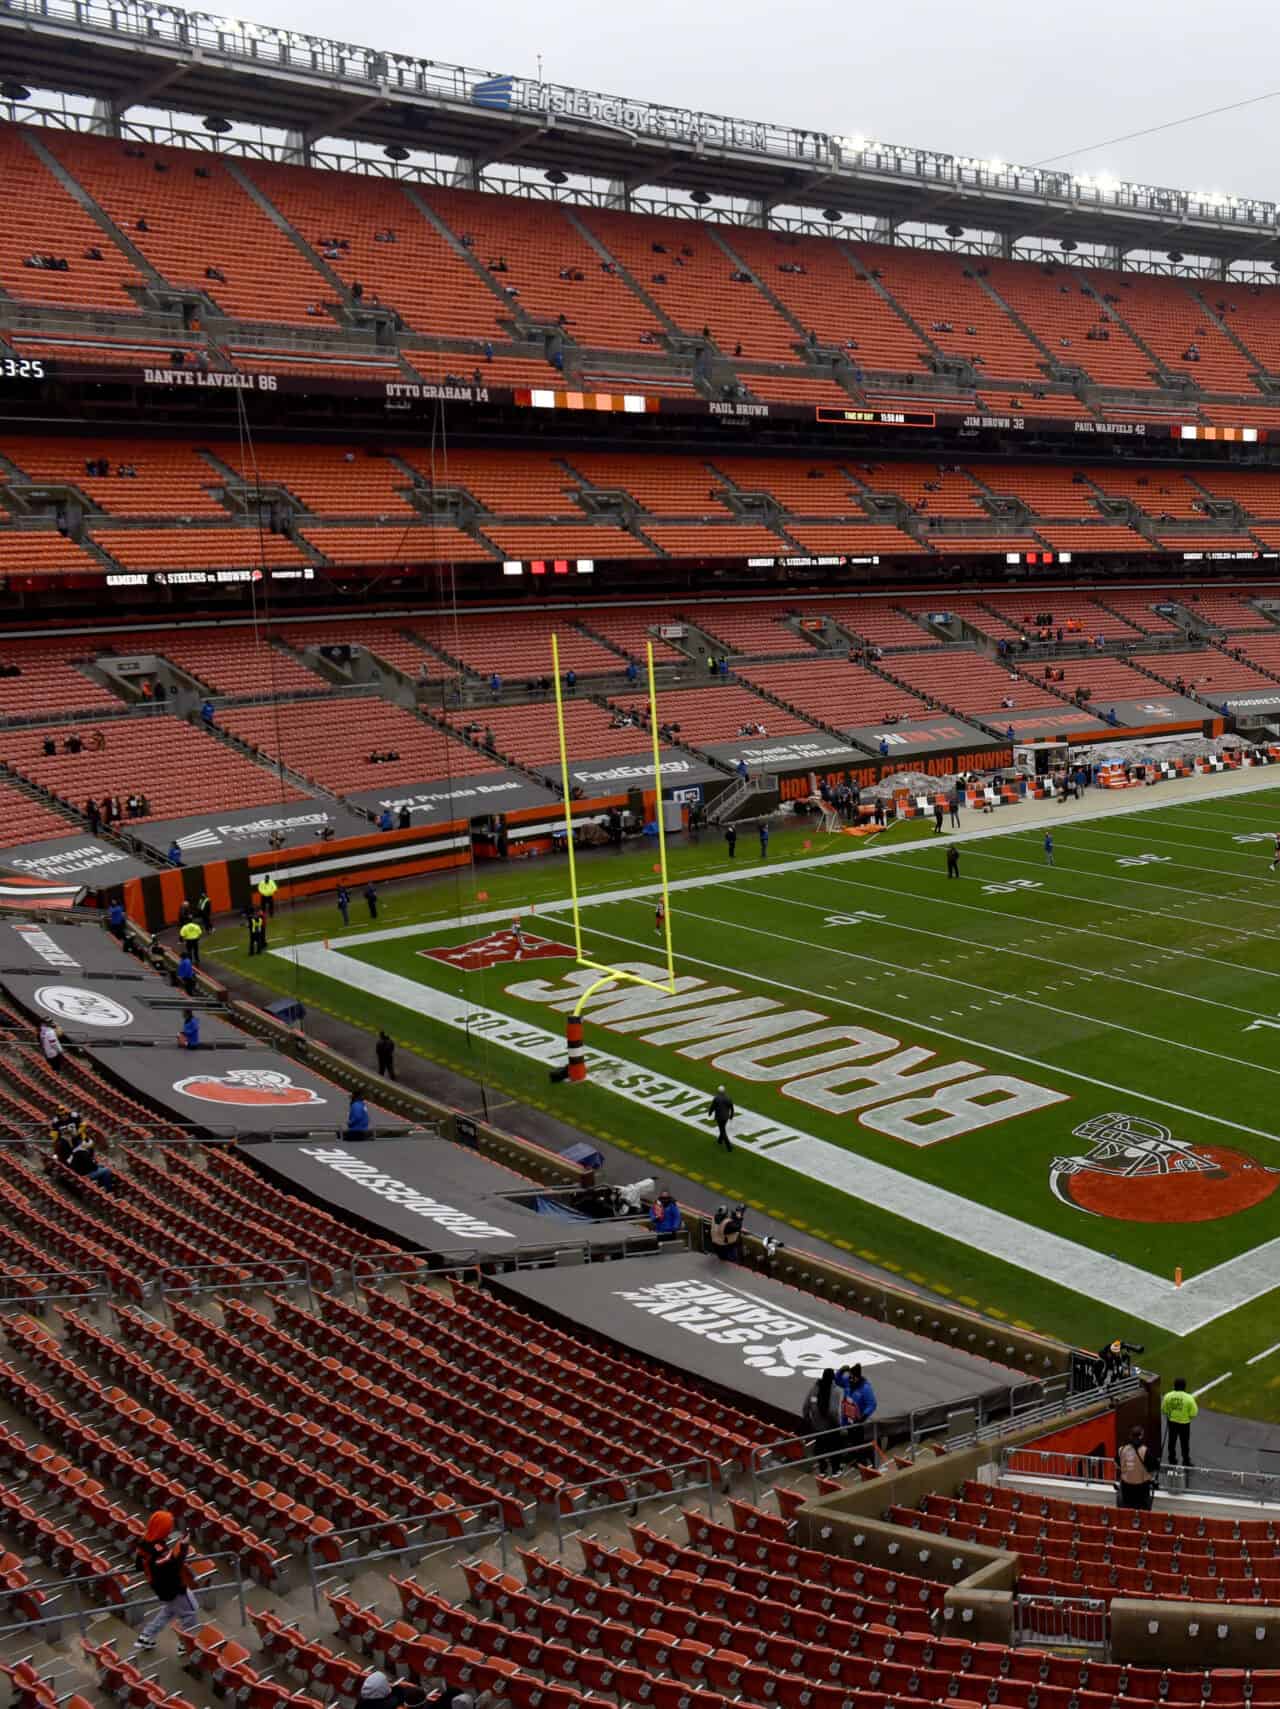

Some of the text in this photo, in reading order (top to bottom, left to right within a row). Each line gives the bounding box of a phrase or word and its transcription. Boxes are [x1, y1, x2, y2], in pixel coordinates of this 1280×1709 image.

[654, 111, 768, 151] STADIUM
[144, 369, 278, 391] DANTE LAVELLI 86
[385, 383, 489, 403] OTTO GRAHAM 14
[964, 416, 980, 427] JIM
[1013, 417, 1025, 430] 32
[880, 757, 954, 783] CLEVELAND
[957, 749, 1014, 771] BROWNS
[217, 811, 329, 835] FirstEnergy
[980, 879, 1044, 896] 20
[823, 910, 887, 927] 10
[453, 1011, 508, 1033] US
[495, 1030, 555, 1049] OF
[504, 961, 1071, 1147] BROWNS
[734, 1126, 800, 1151] IT
[298, 1146, 518, 1240] BRIDGESTONE
[611, 1290, 764, 1344] STAY
